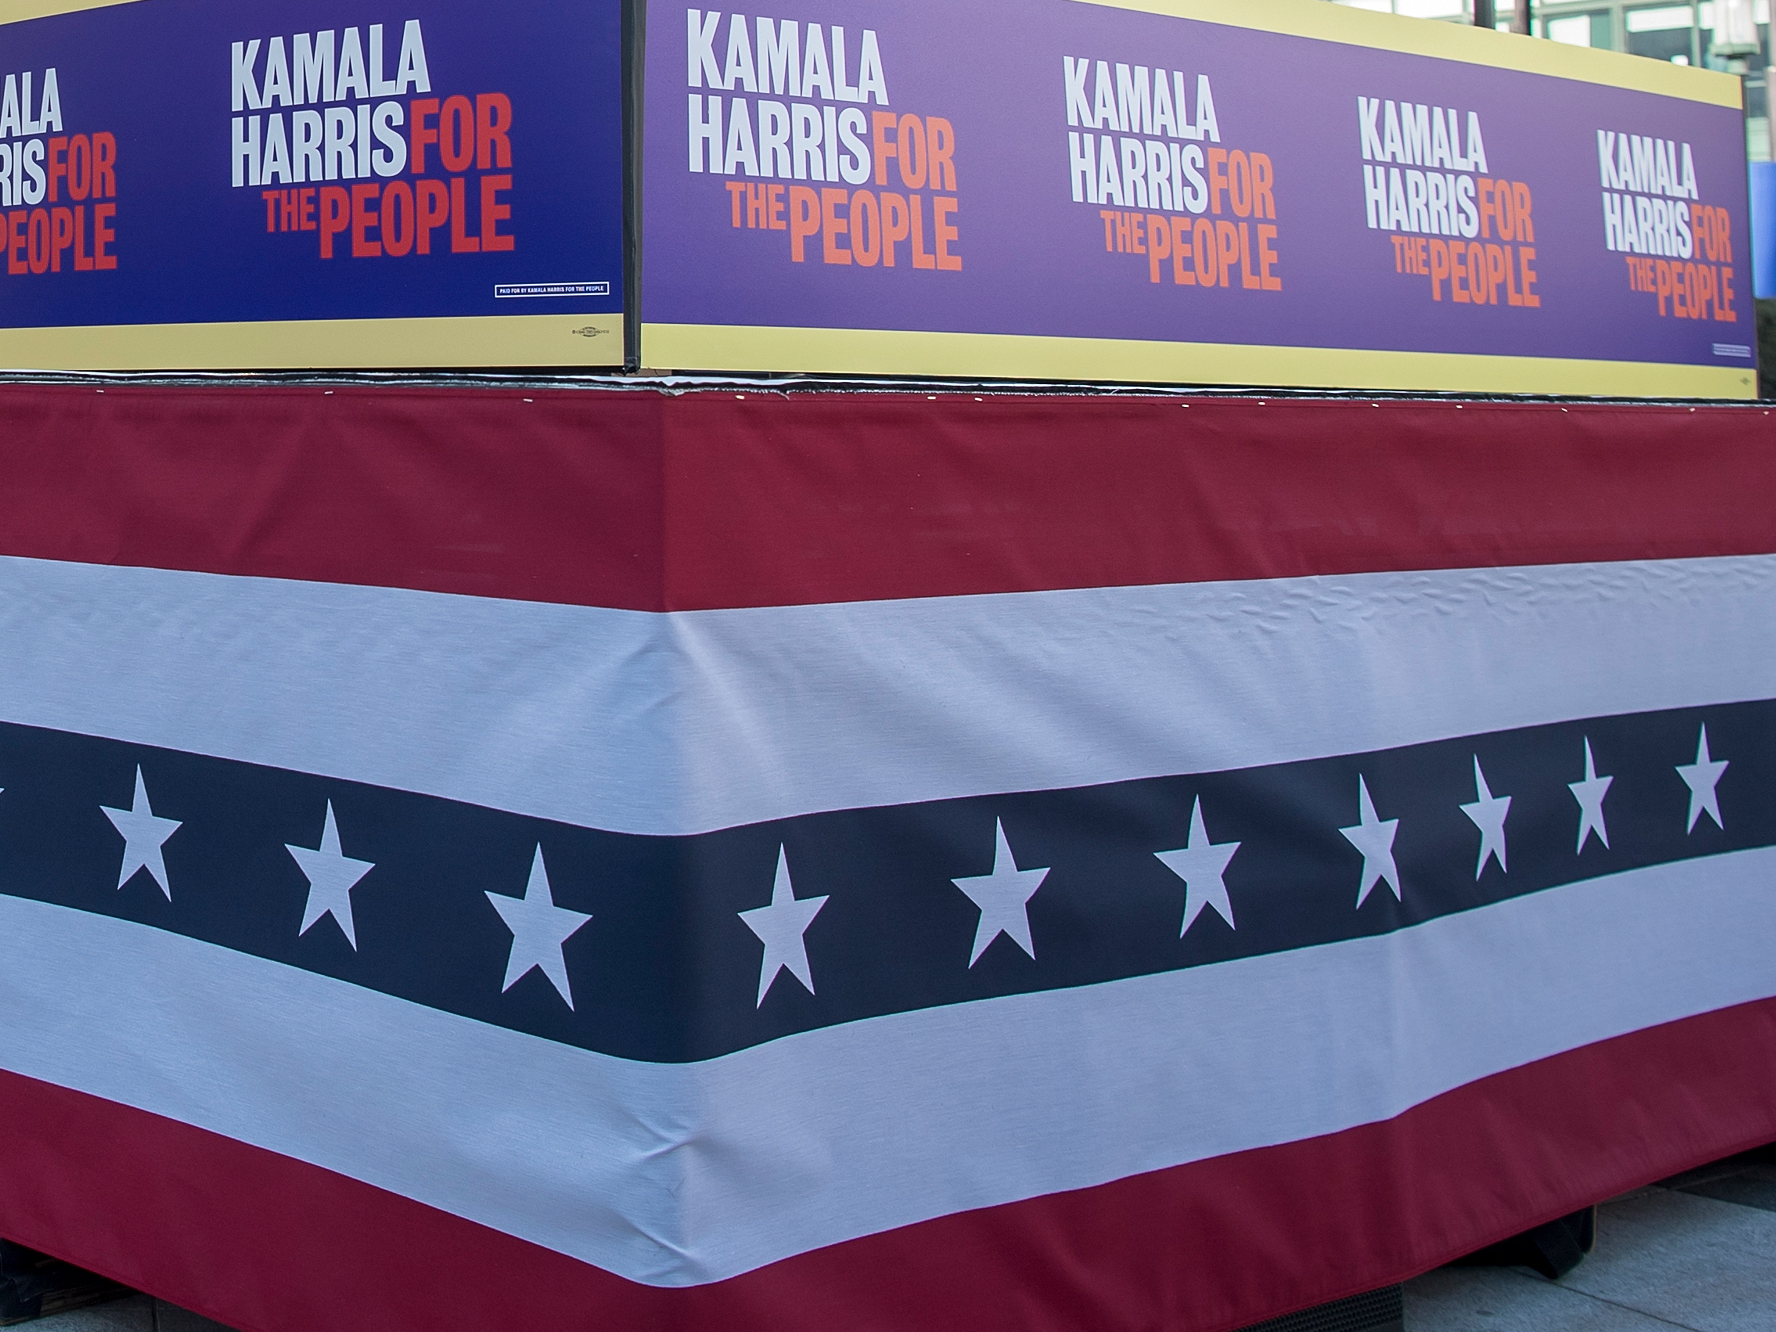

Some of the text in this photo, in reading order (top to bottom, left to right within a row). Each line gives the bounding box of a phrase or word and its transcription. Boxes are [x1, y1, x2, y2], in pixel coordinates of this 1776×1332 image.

[231, 19, 431, 111] KAMALA
[687, 8, 889, 105] KAMALA
[231, 92, 512, 188] HARRIS FOR
[1063, 55, 1221, 143] KAMALA
[1357, 95, 1489, 174] KAMALA
[48, 131, 116, 202] FOR
[688, 93, 957, 192] HARRIS FOR
[1068, 131, 1276, 219] HARRIS FOR
[1596, 129, 1699, 200] KAMALA
[262, 174, 515, 259] THE PEOPLE
[725, 181, 962, 271] THE PEOPLE
[1363, 164, 1535, 243] HARRIS FOR
[1601, 191, 1733, 263] HARRIS FOR
[1100, 210, 1283, 291] THE PEOPLE
[1390, 235, 1541, 308] THE PEOPLE
[1626, 256, 1737, 322] THE PEOPLE
